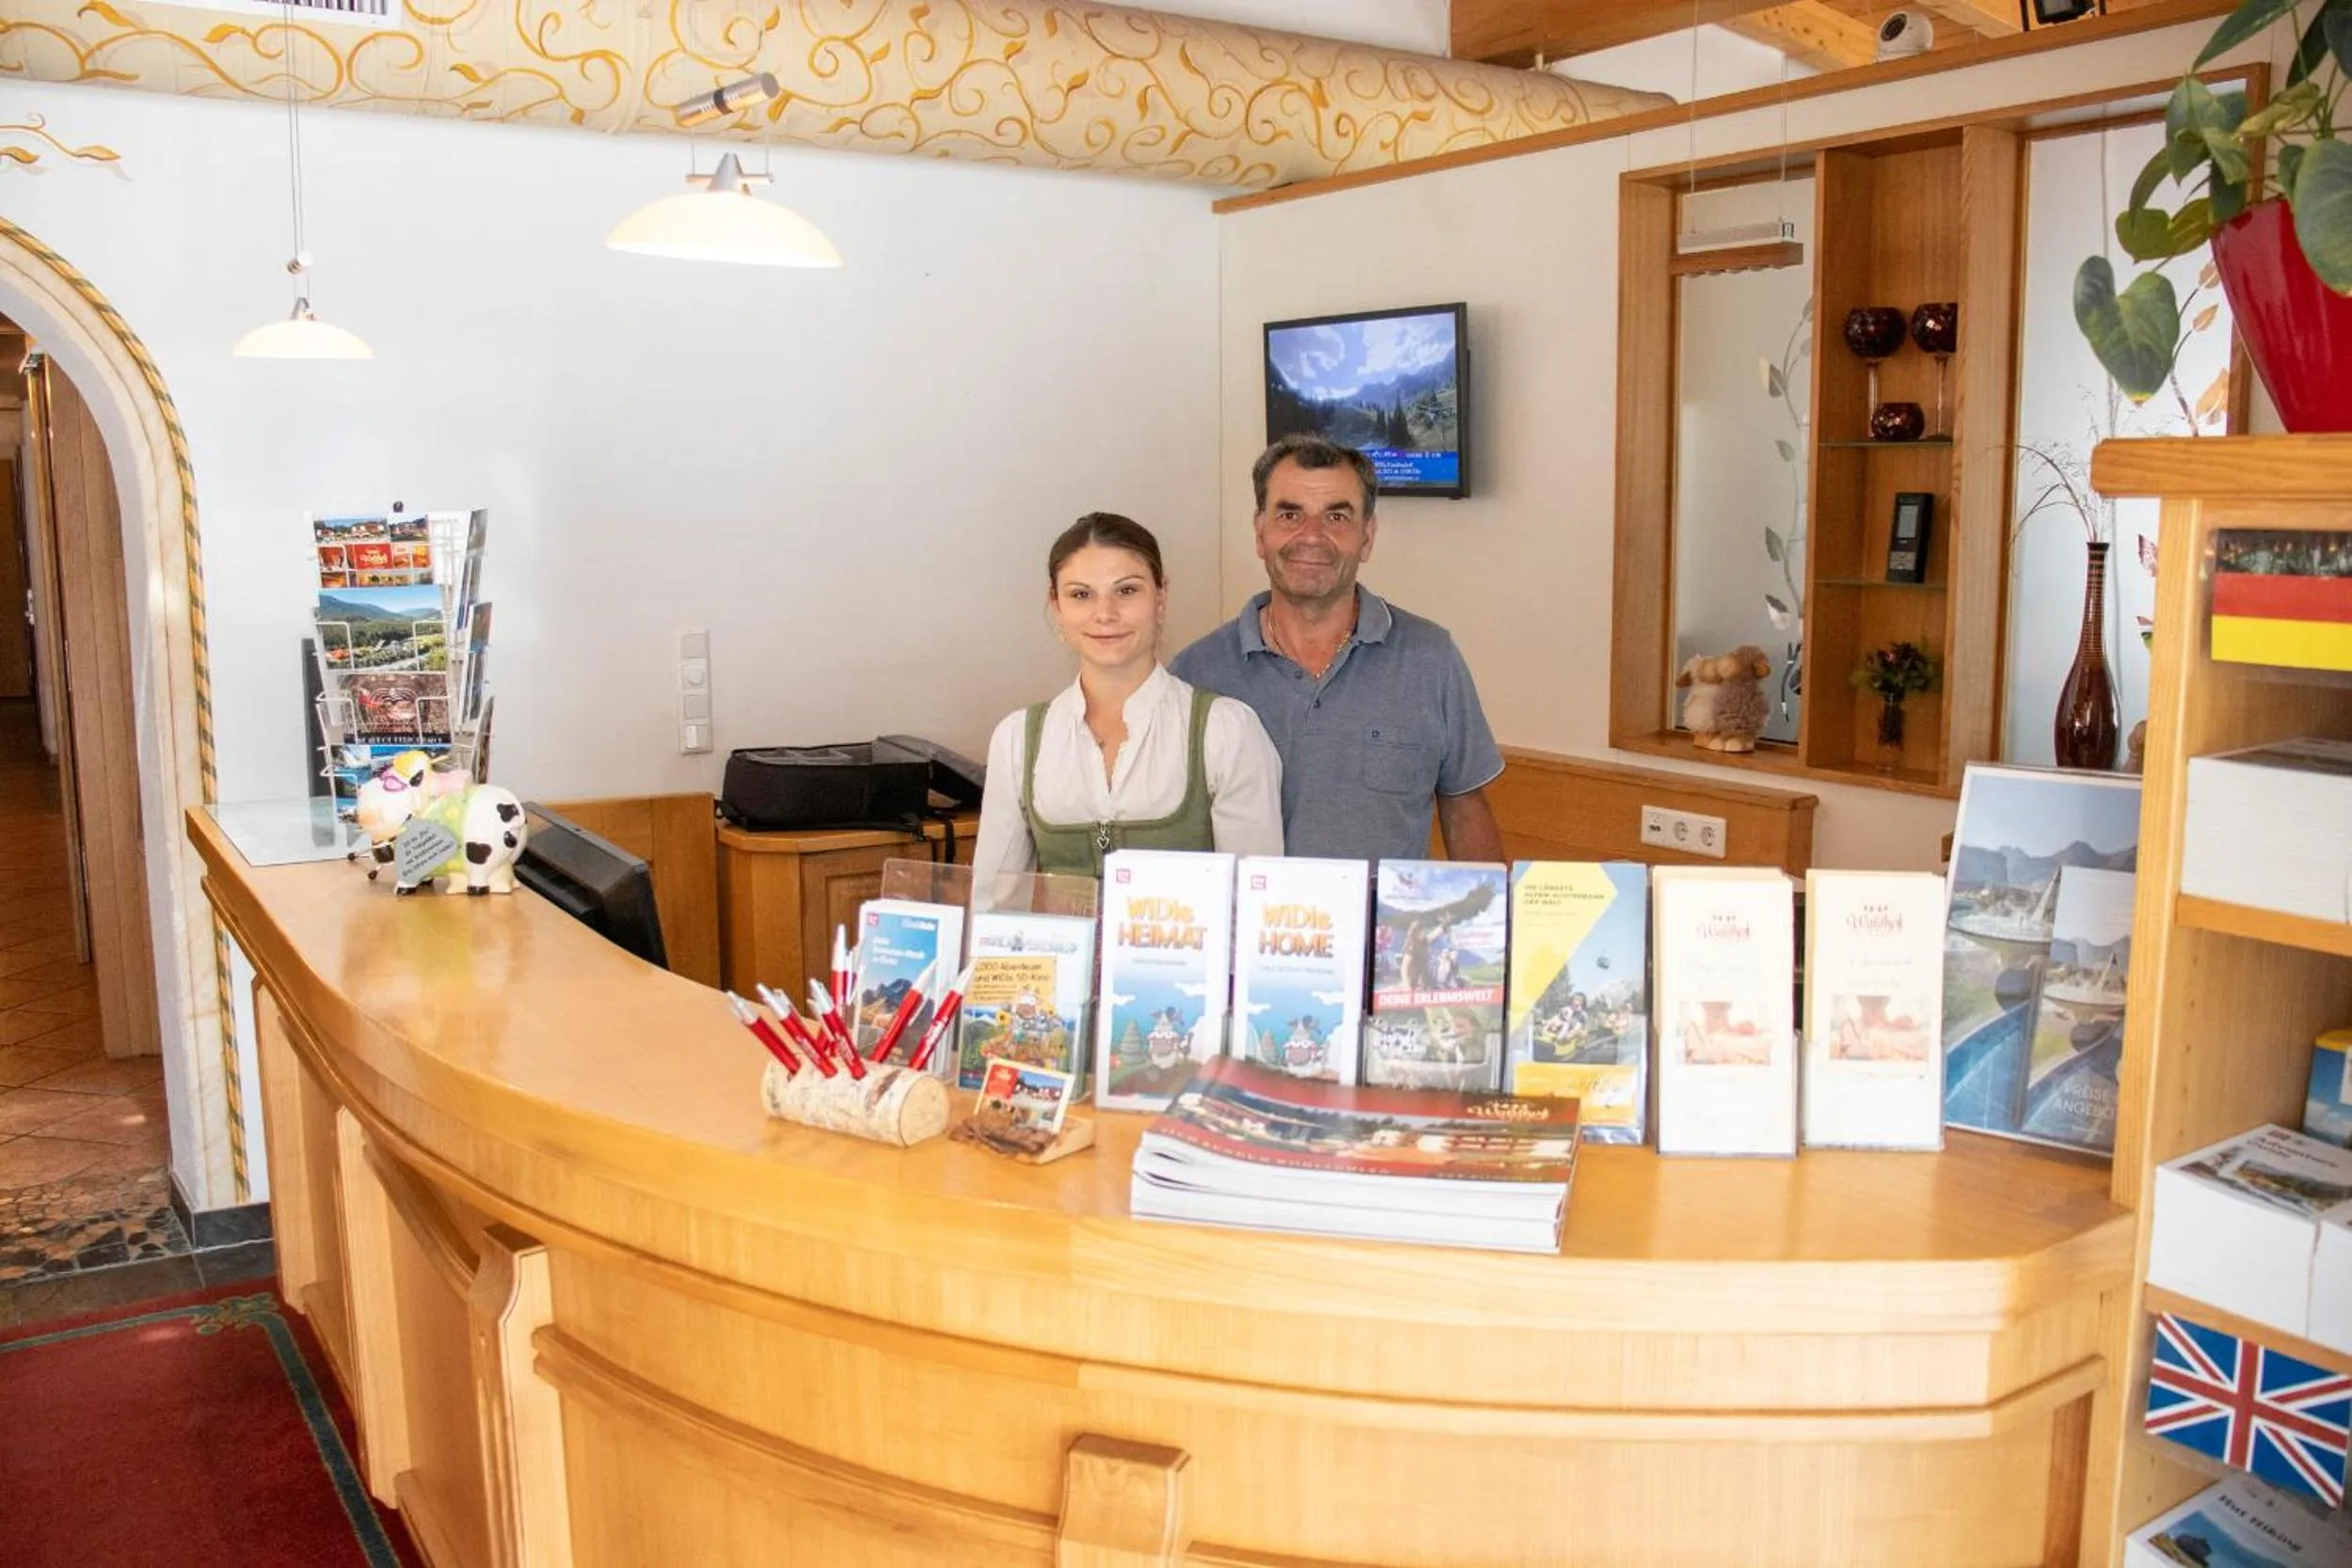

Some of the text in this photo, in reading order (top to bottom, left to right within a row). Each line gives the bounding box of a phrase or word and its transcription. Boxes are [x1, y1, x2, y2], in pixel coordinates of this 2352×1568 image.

[1117, 921, 1208, 950] HEIMAT
[1259, 929, 1334, 958] HOME
[1378, 988, 1494, 1006] DEINE ERLEBNISWELT
